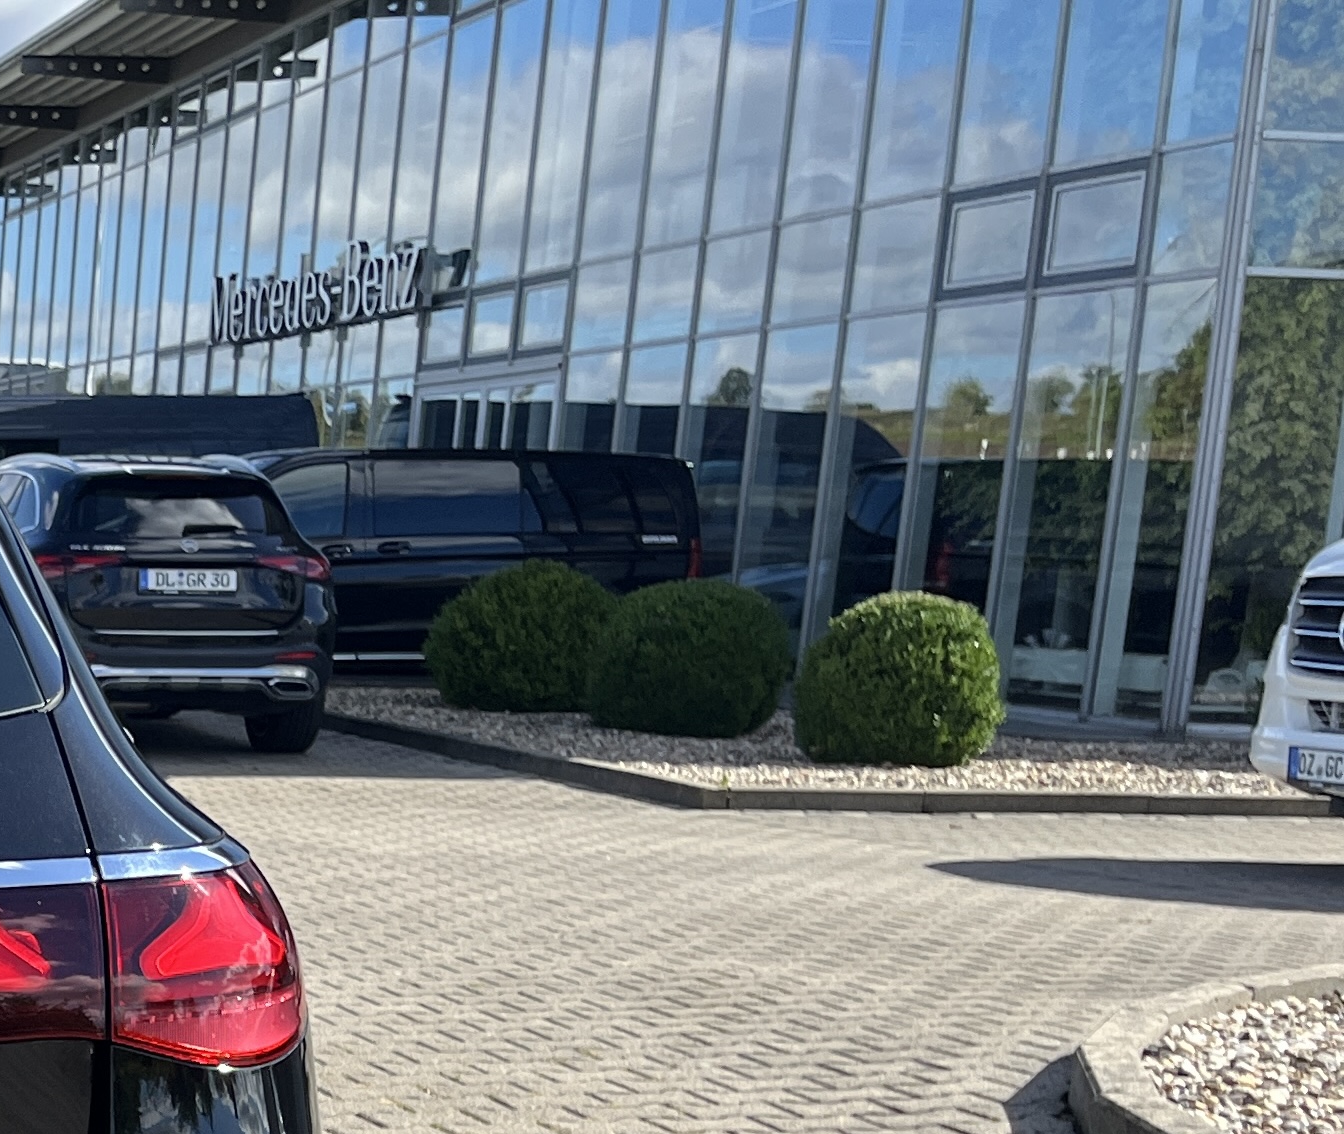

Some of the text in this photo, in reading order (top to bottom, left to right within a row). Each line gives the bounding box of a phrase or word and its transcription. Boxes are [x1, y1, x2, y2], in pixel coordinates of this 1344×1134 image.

[212, 240, 420, 343] Mercedes-Benz
[156, 572, 230, 588] DL GR 30
